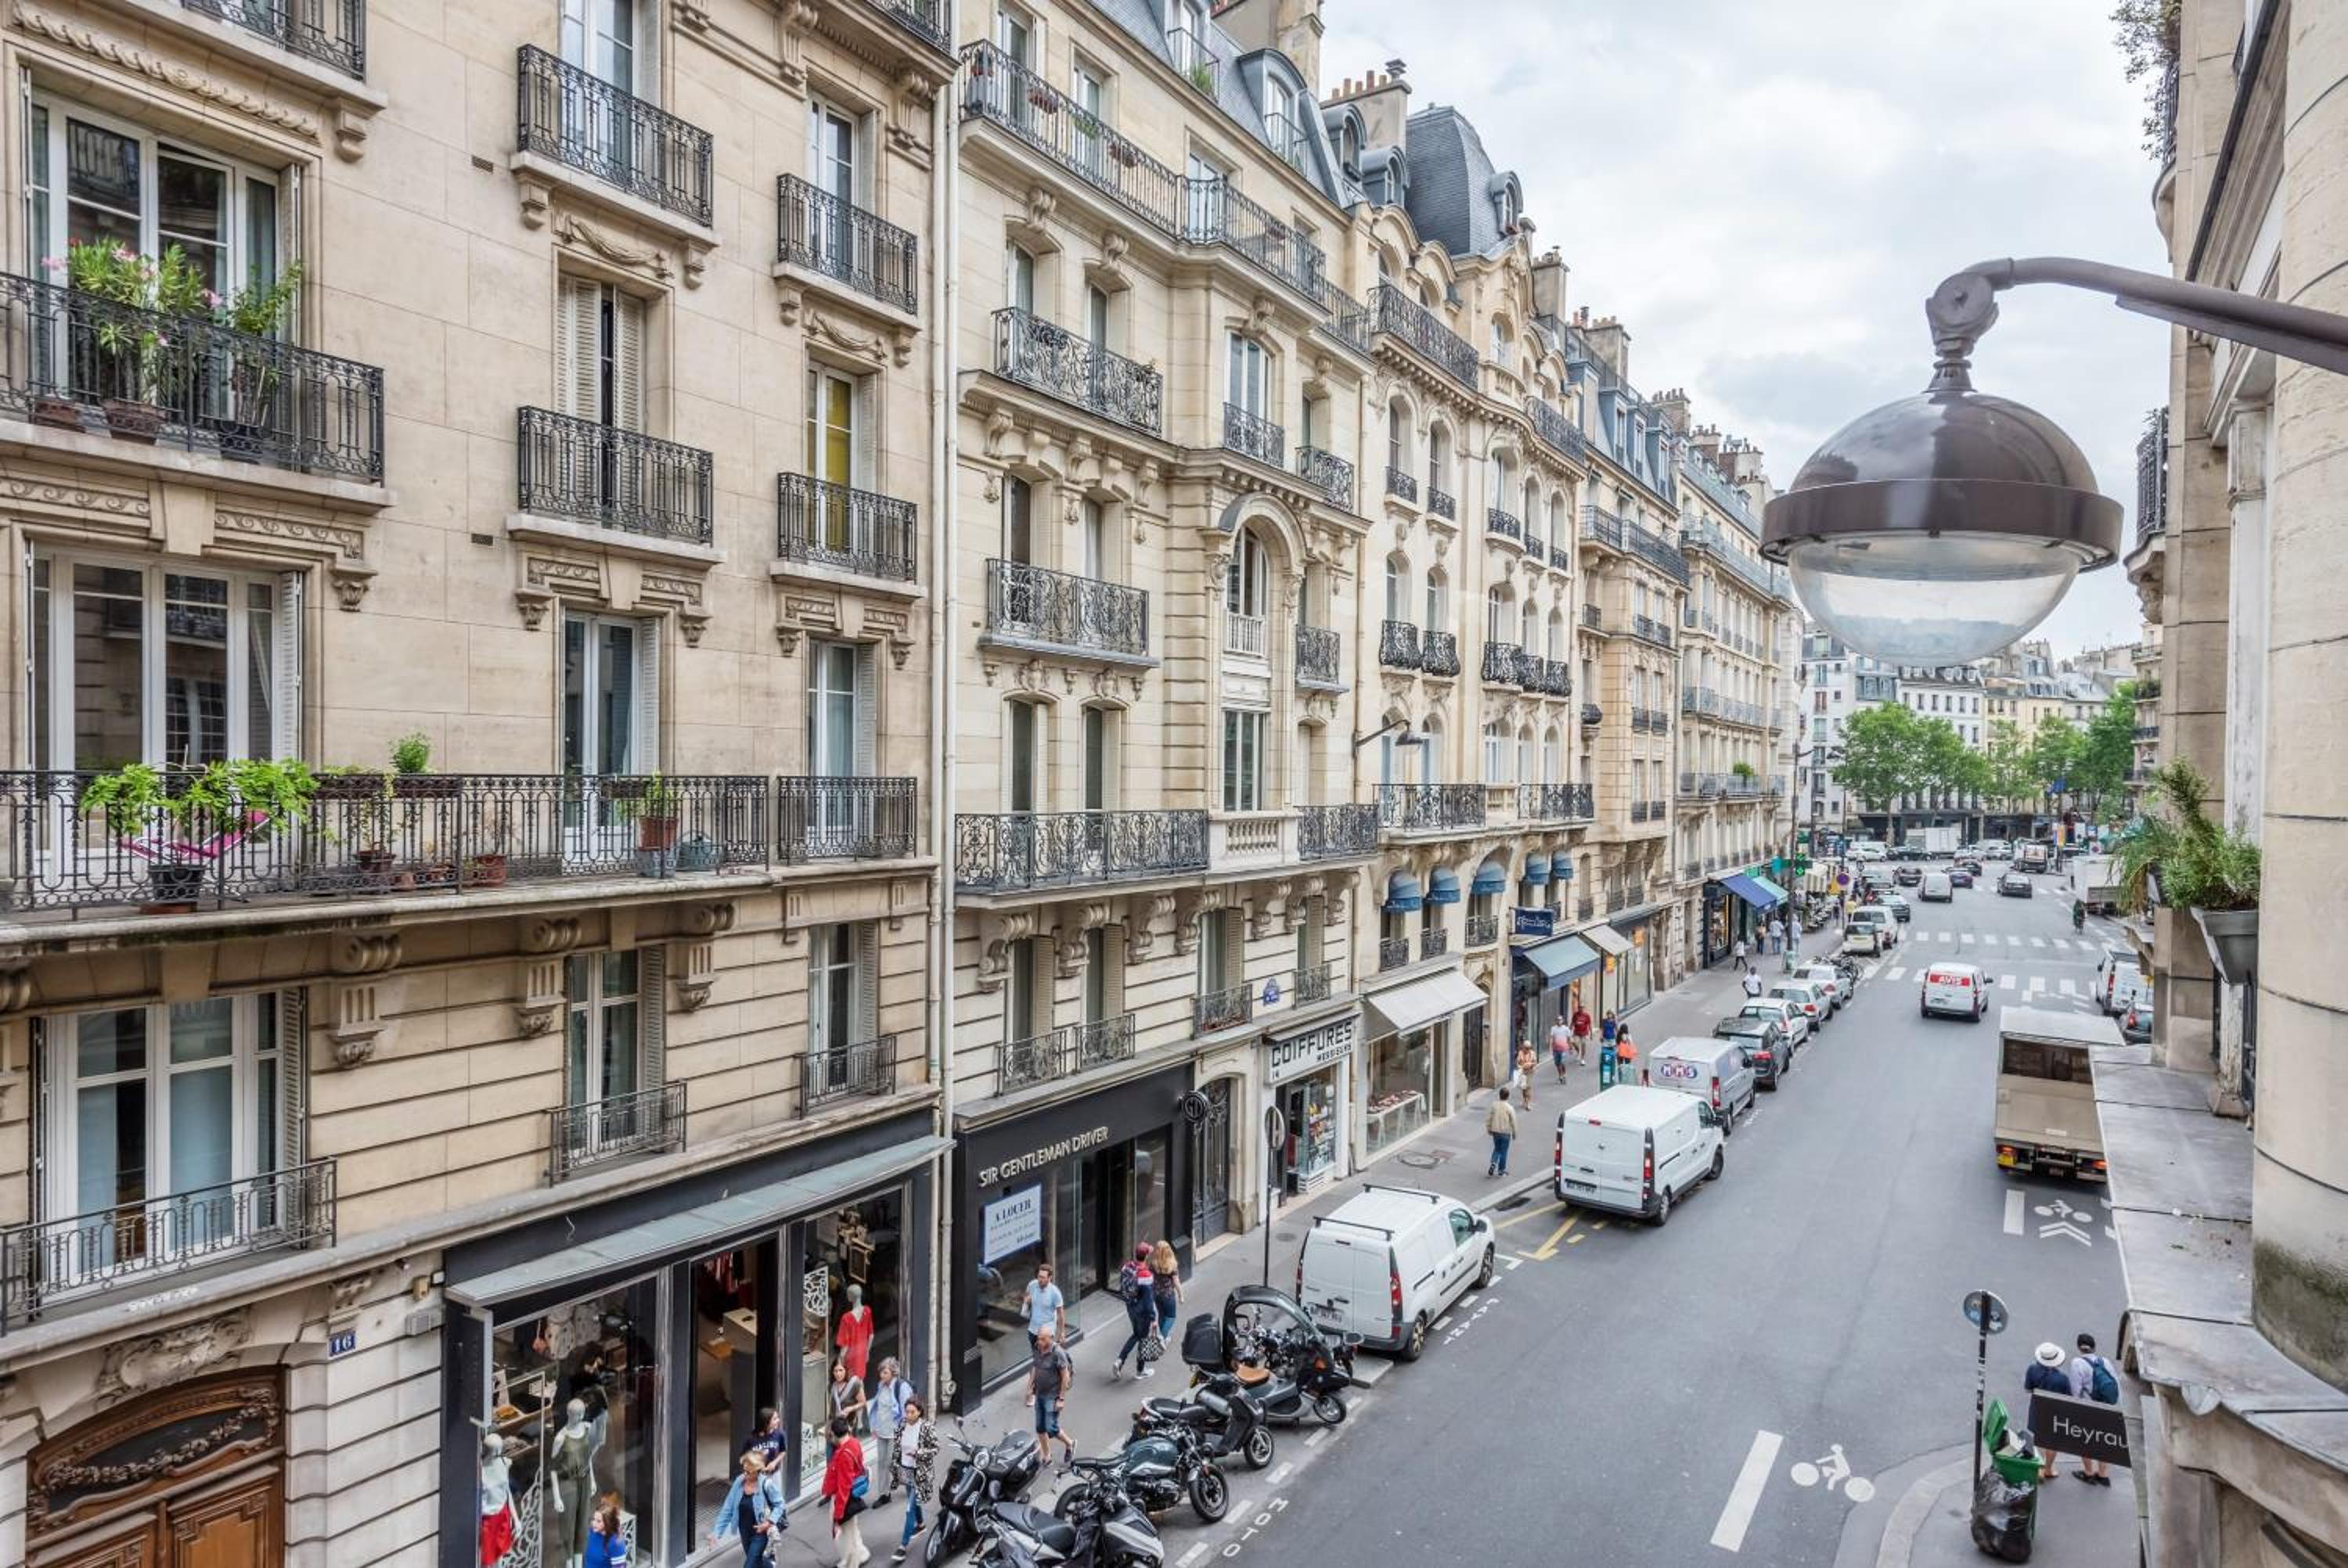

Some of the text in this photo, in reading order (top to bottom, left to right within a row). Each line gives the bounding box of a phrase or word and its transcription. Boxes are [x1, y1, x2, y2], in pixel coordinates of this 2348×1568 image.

[1272, 1020, 1352, 1067] COIFFURES
[1663, 1064, 1695, 1078] MMS
[979, 1125, 1110, 1188] SIR GENTLEMAN DRIVER
[334, 1336, 352, 1352] 16
[1222, 1497, 1290, 1557] MOTO
